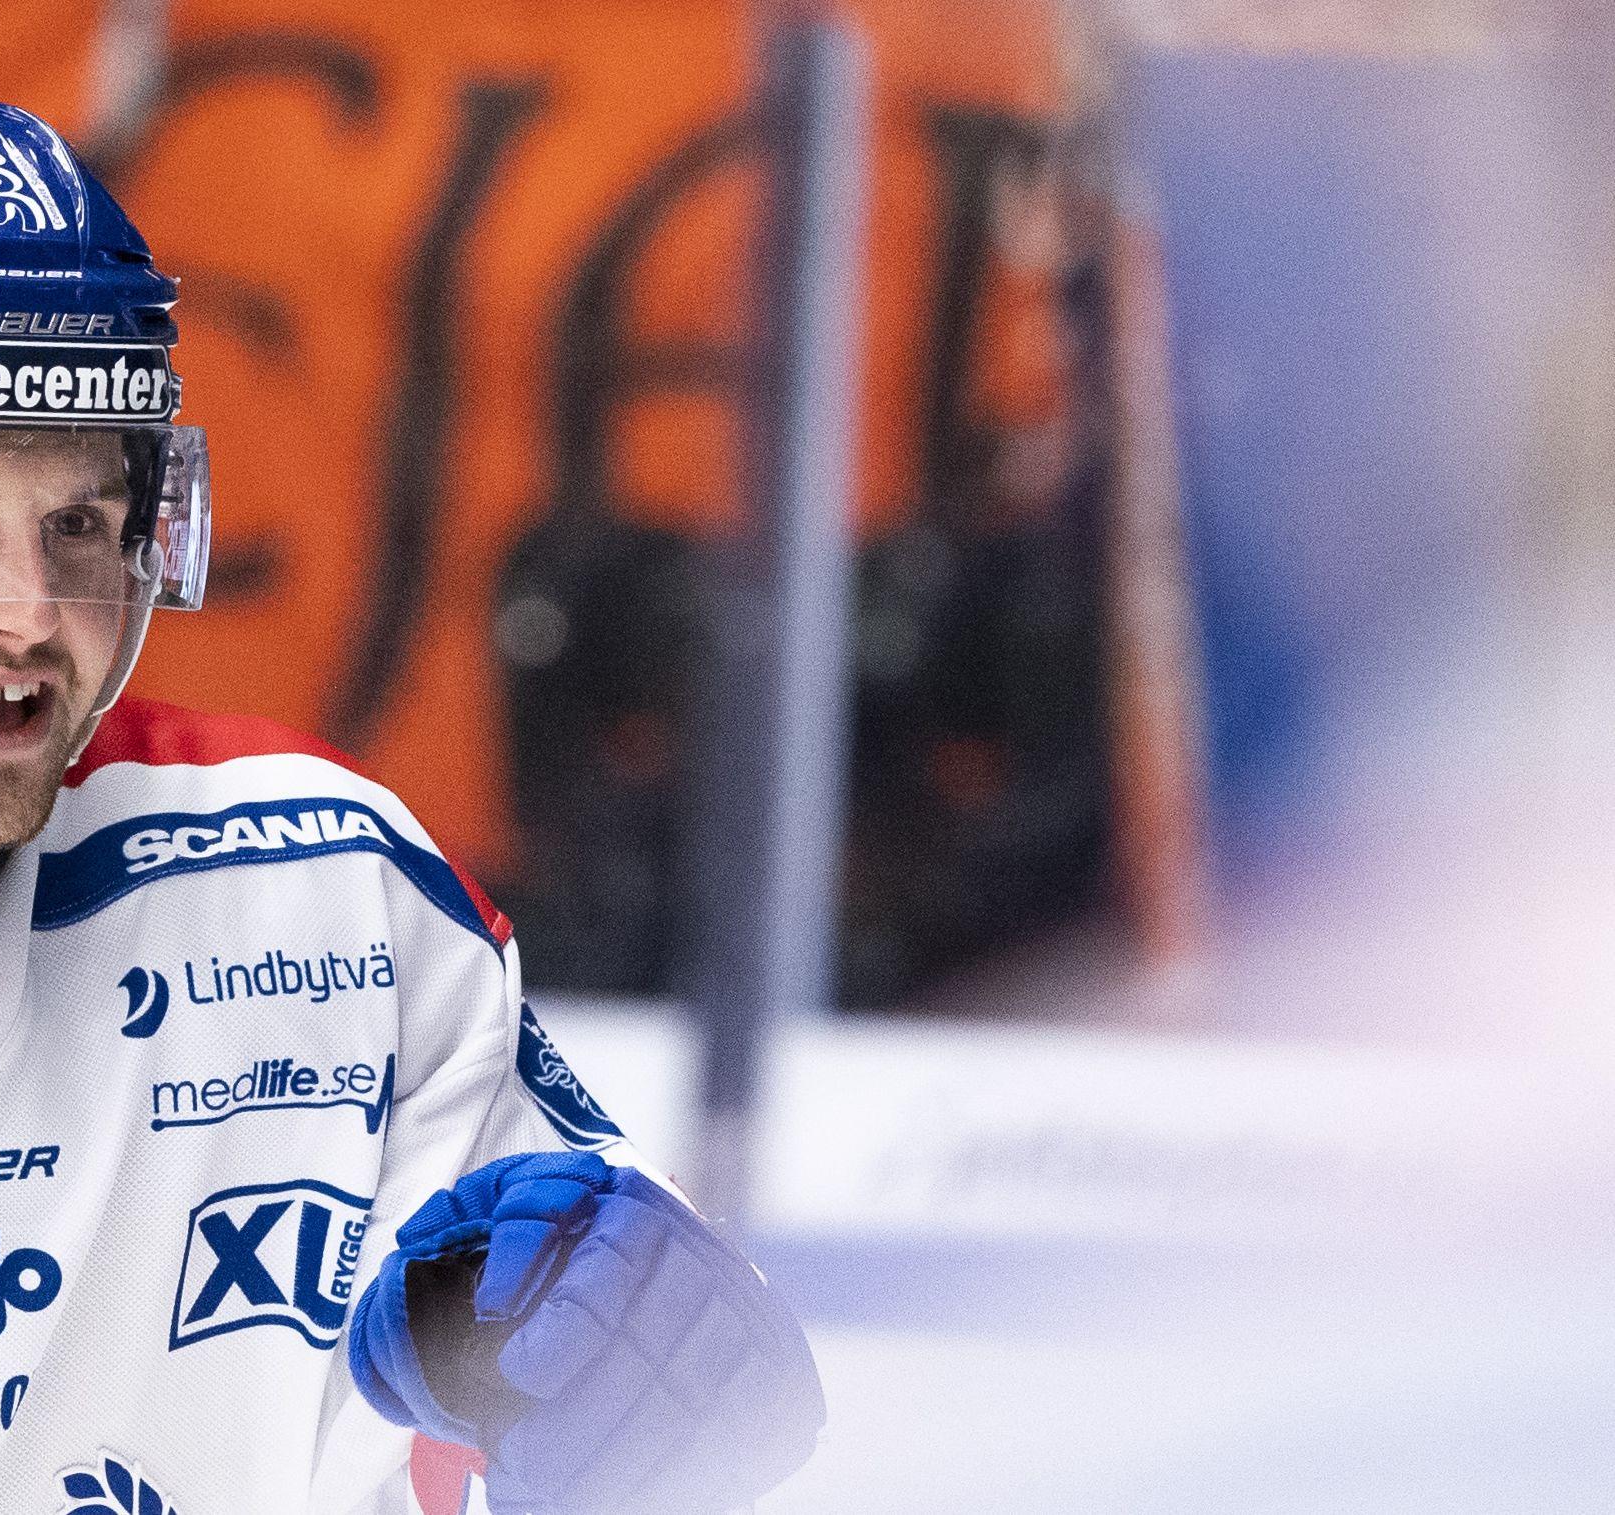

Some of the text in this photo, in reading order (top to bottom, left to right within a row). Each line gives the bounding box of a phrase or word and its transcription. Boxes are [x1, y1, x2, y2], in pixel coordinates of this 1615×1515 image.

[121, 809, 395, 875] SCANIA
[152, 1058, 377, 1114] medlife.se
[182, 1199, 349, 1331] XL
